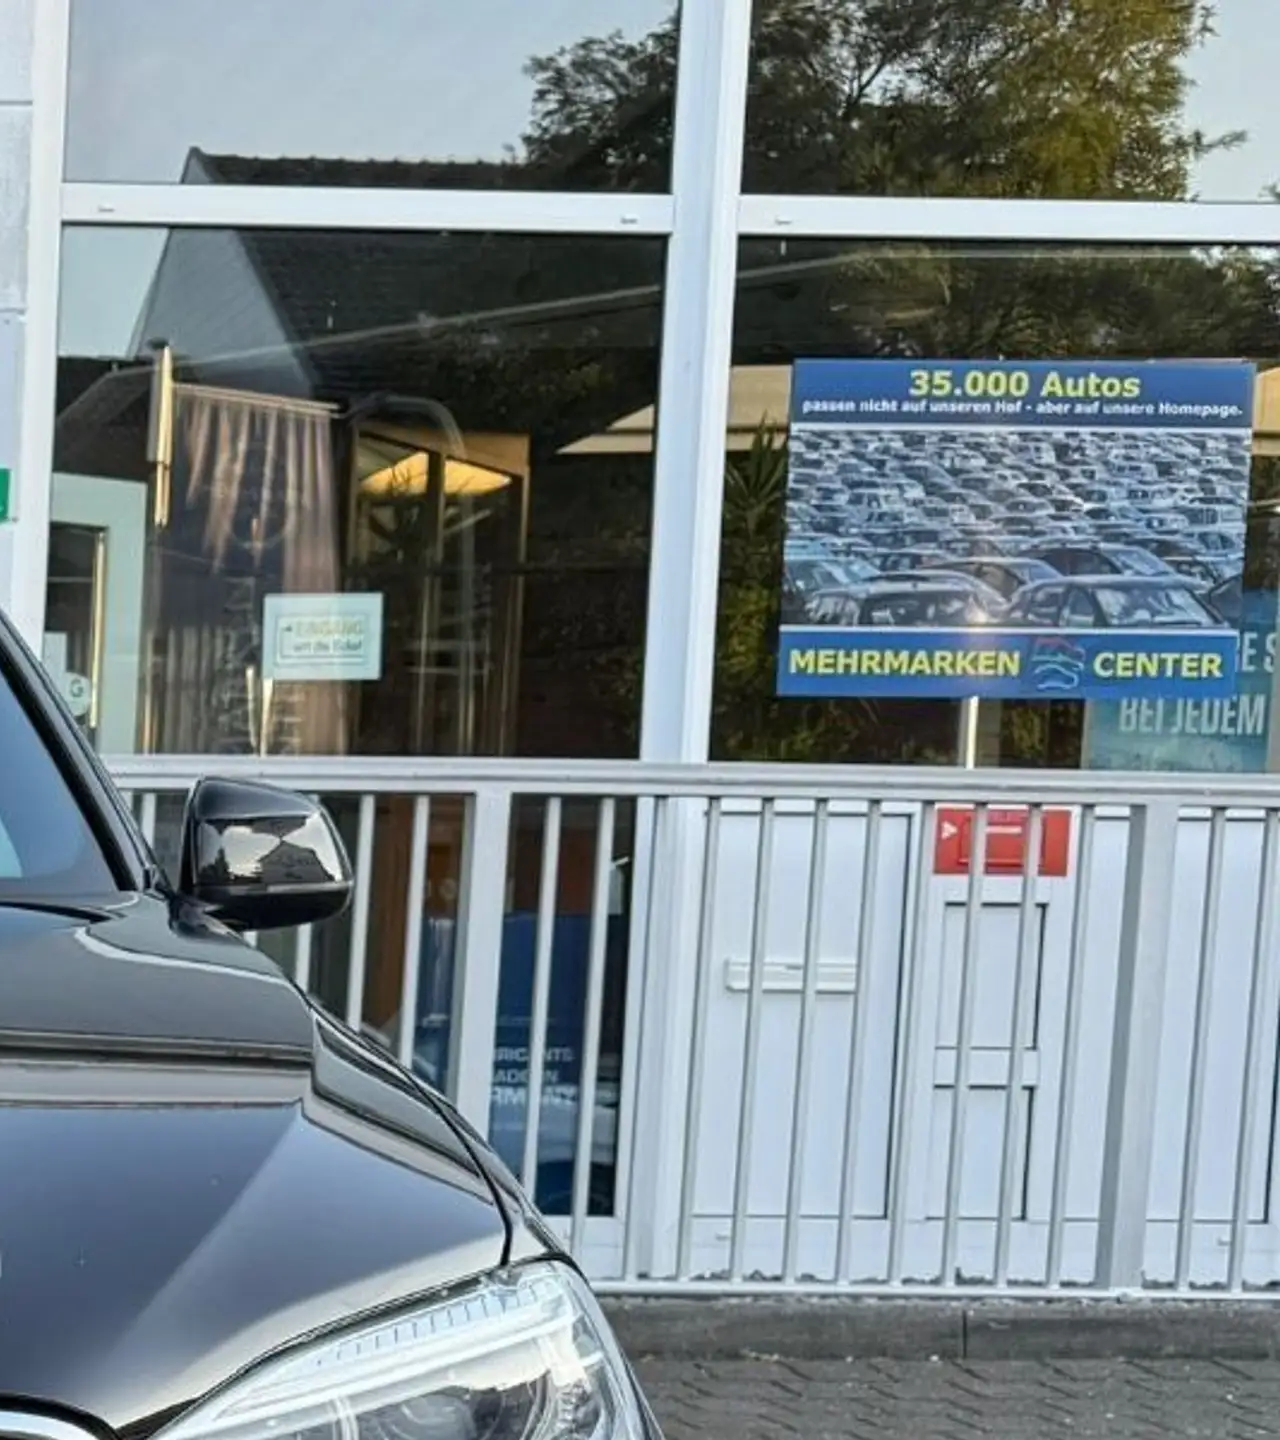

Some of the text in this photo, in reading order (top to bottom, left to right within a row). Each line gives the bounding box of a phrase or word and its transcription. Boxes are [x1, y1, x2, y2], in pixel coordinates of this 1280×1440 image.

[908, 370, 1141, 398] 35.000 Autos
[802, 400, 856, 414] passen
[860, 399, 898, 413] nicht
[901, 399, 926, 413] auf
[929, 402, 992, 413] unseren
[995, 400, 1022, 413] Hof
[1036, 400, 1072, 415] aber
[1074, 401, 1100, 415] auf
[1102, 403, 1155, 415] unsere
[1158, 402, 1243, 419] Homepage.
[788, 649, 1021, 677] MEHRMARKEN
[1093, 652, 1224, 679] CENTER
